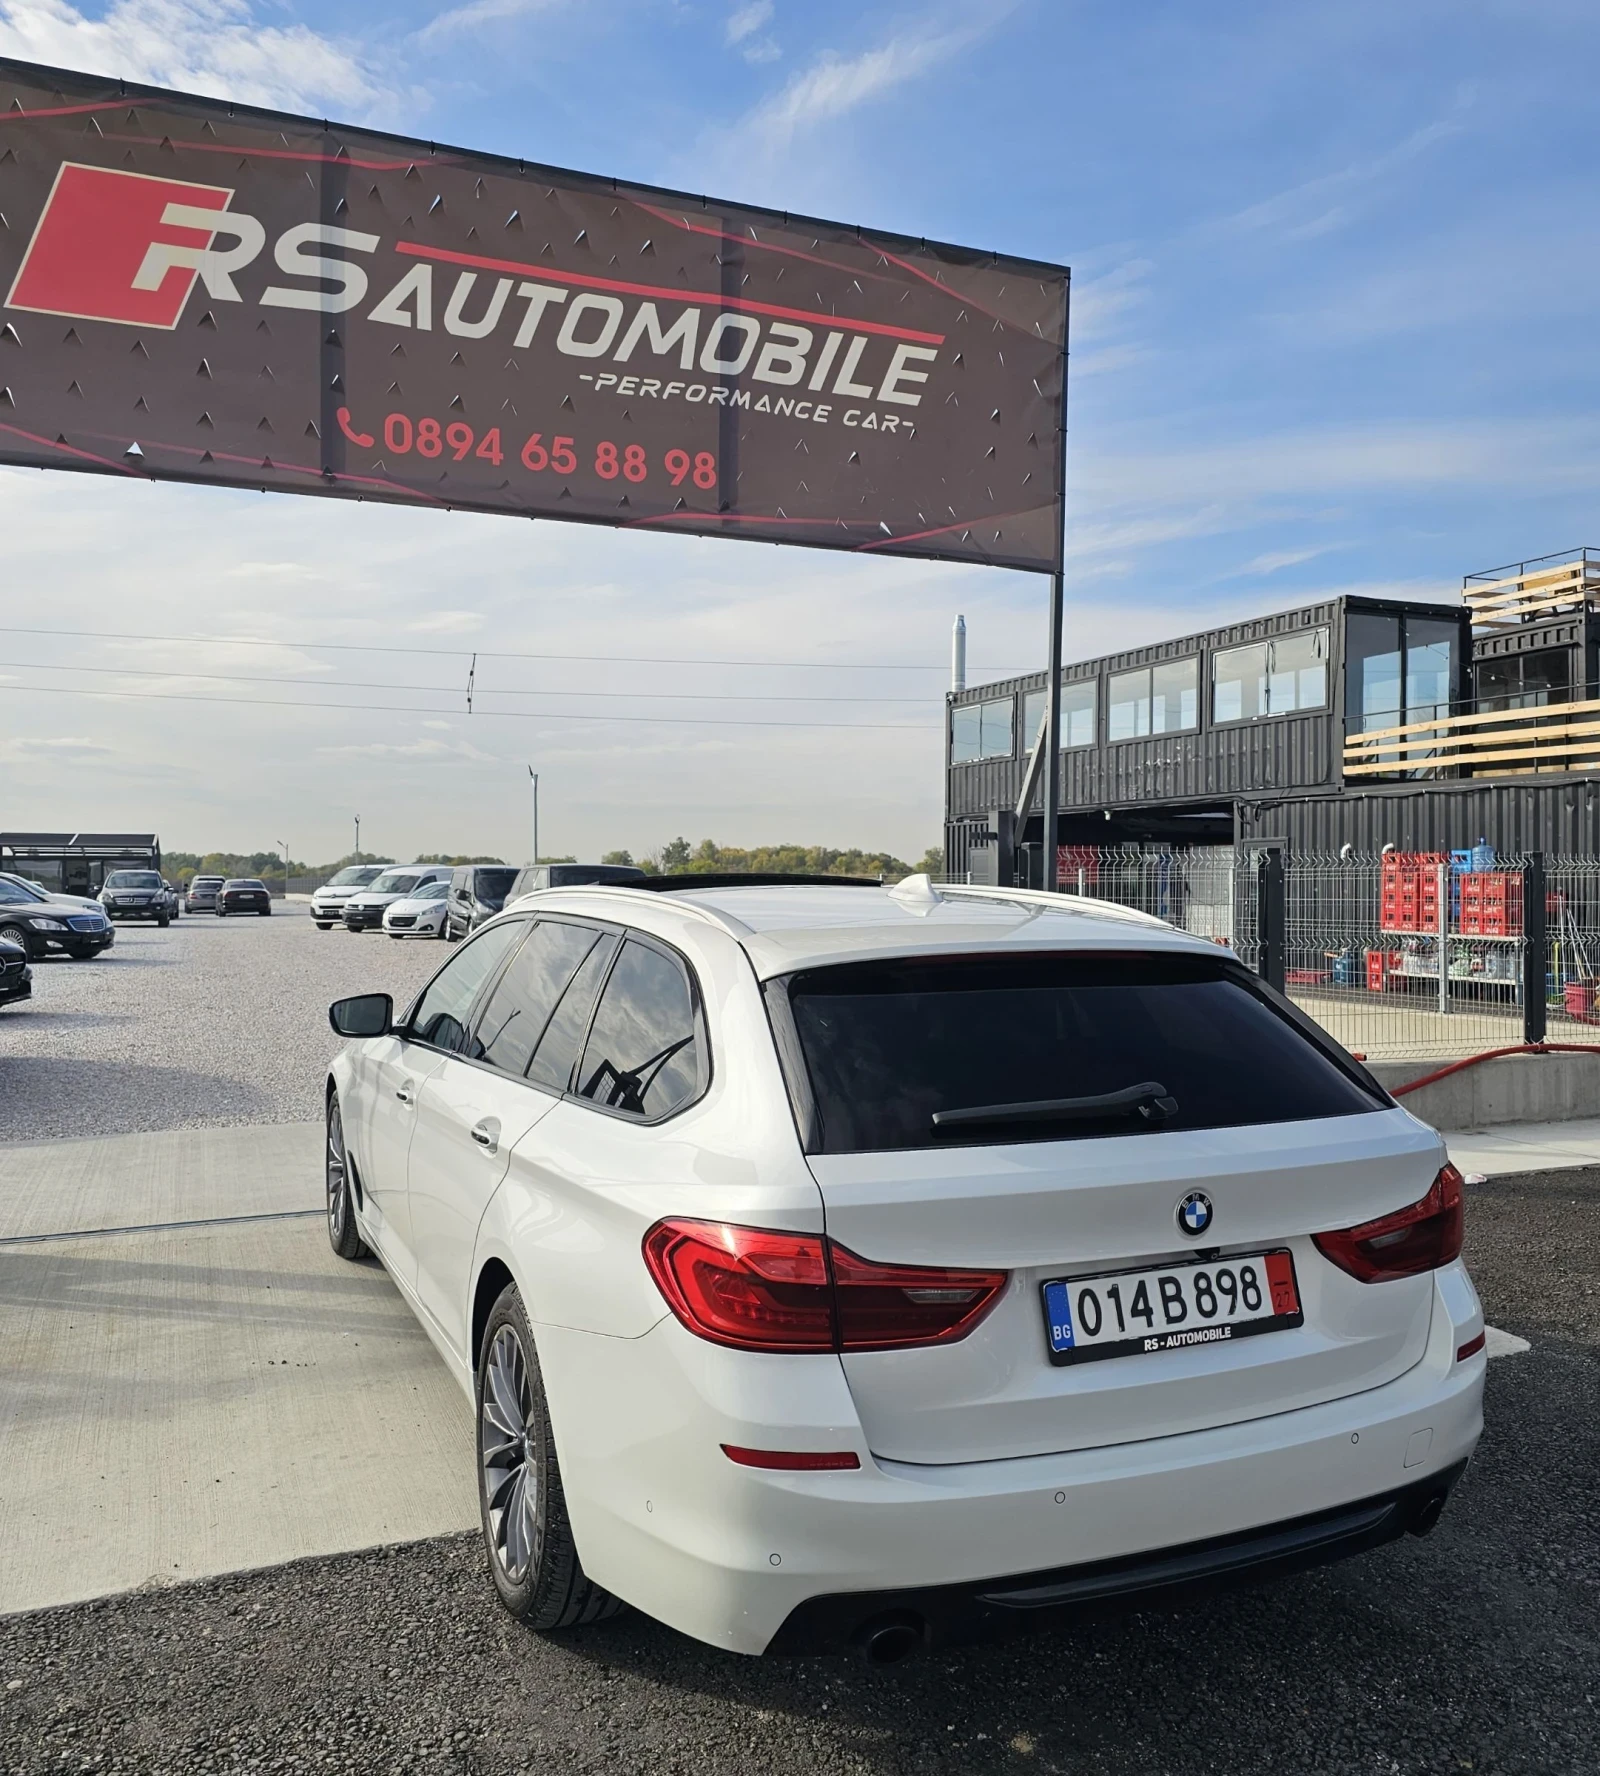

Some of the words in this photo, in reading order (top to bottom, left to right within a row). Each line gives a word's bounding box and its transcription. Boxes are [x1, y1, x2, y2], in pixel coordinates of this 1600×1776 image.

[131, 203, 380, 313] RS
[367, 263, 938, 406] AUTOMOBILE
[384, 413, 503, 466] 0894
[521, 433, 577, 474] 65
[595, 441, 647, 482] 88
[664, 449, 717, 489] 98
[1181, 1193, 1211, 1209] BMW
[1053, 1325, 1071, 1341] BG
